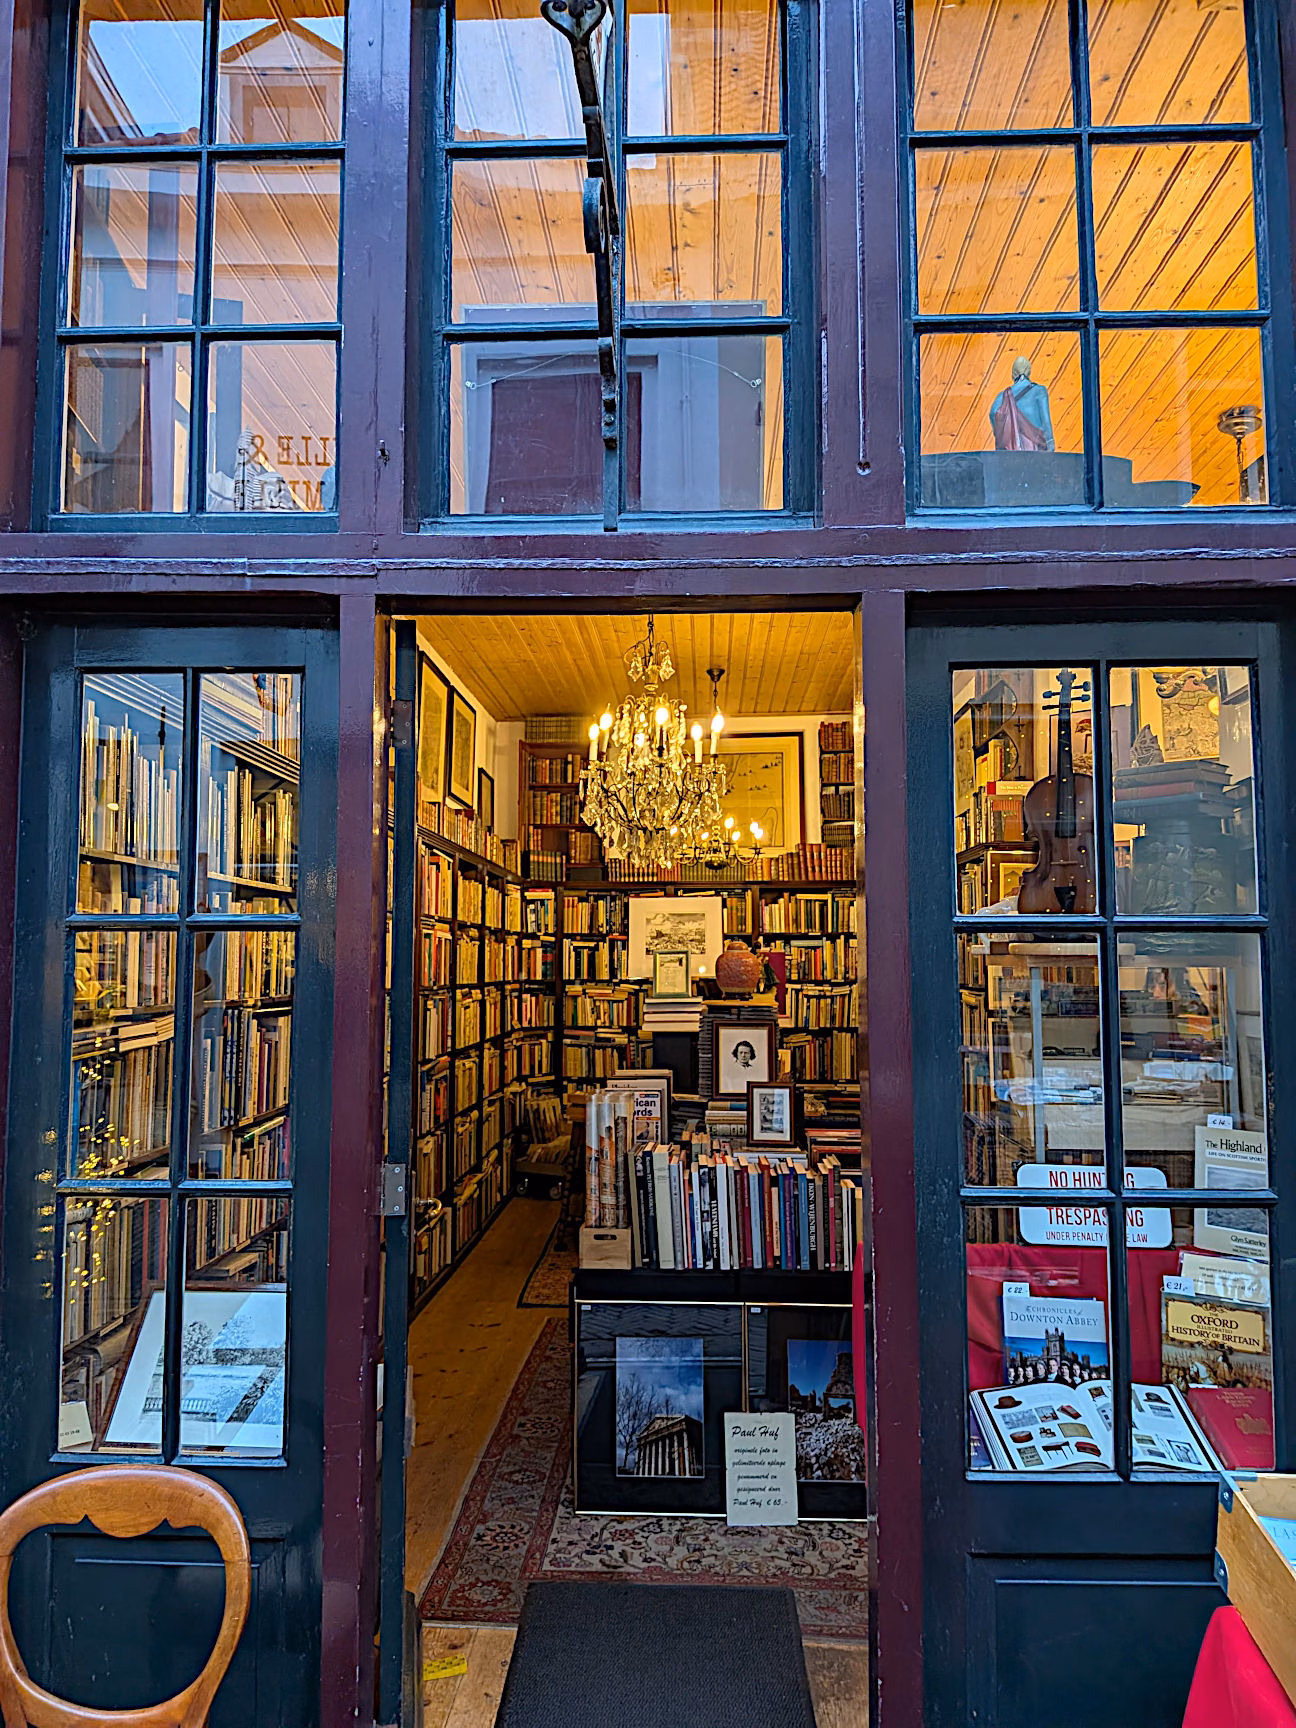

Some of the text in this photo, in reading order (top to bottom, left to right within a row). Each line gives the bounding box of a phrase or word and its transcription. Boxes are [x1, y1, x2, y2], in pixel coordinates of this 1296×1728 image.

[633, 1097, 656, 1107] ican
[1205, 1139, 1218, 1149] The
[1220, 1138, 1262, 1154] Highland
[1049, 1170, 1135, 1189] NO HUNG
[1045, 1231, 1071, 1241] UNDER
[1072, 1232, 1104, 1242] PENALTY
[1132, 1233, 1148, 1243] LAW
[1166, 1281, 1172, 1290] €
[1010, 1311, 1098, 1326] DOWNTON ABBEY
[1191, 1314, 1239, 1329] OXFORD
[1171, 1325, 1213, 1339] HISTORY
[1221, 1333, 1260, 1347] BRITAIN
[731, 1425, 780, 1441] Paul Huf
[732, 1498, 749, 1506] Paul
[749, 1498, 763, 1508] Huf
